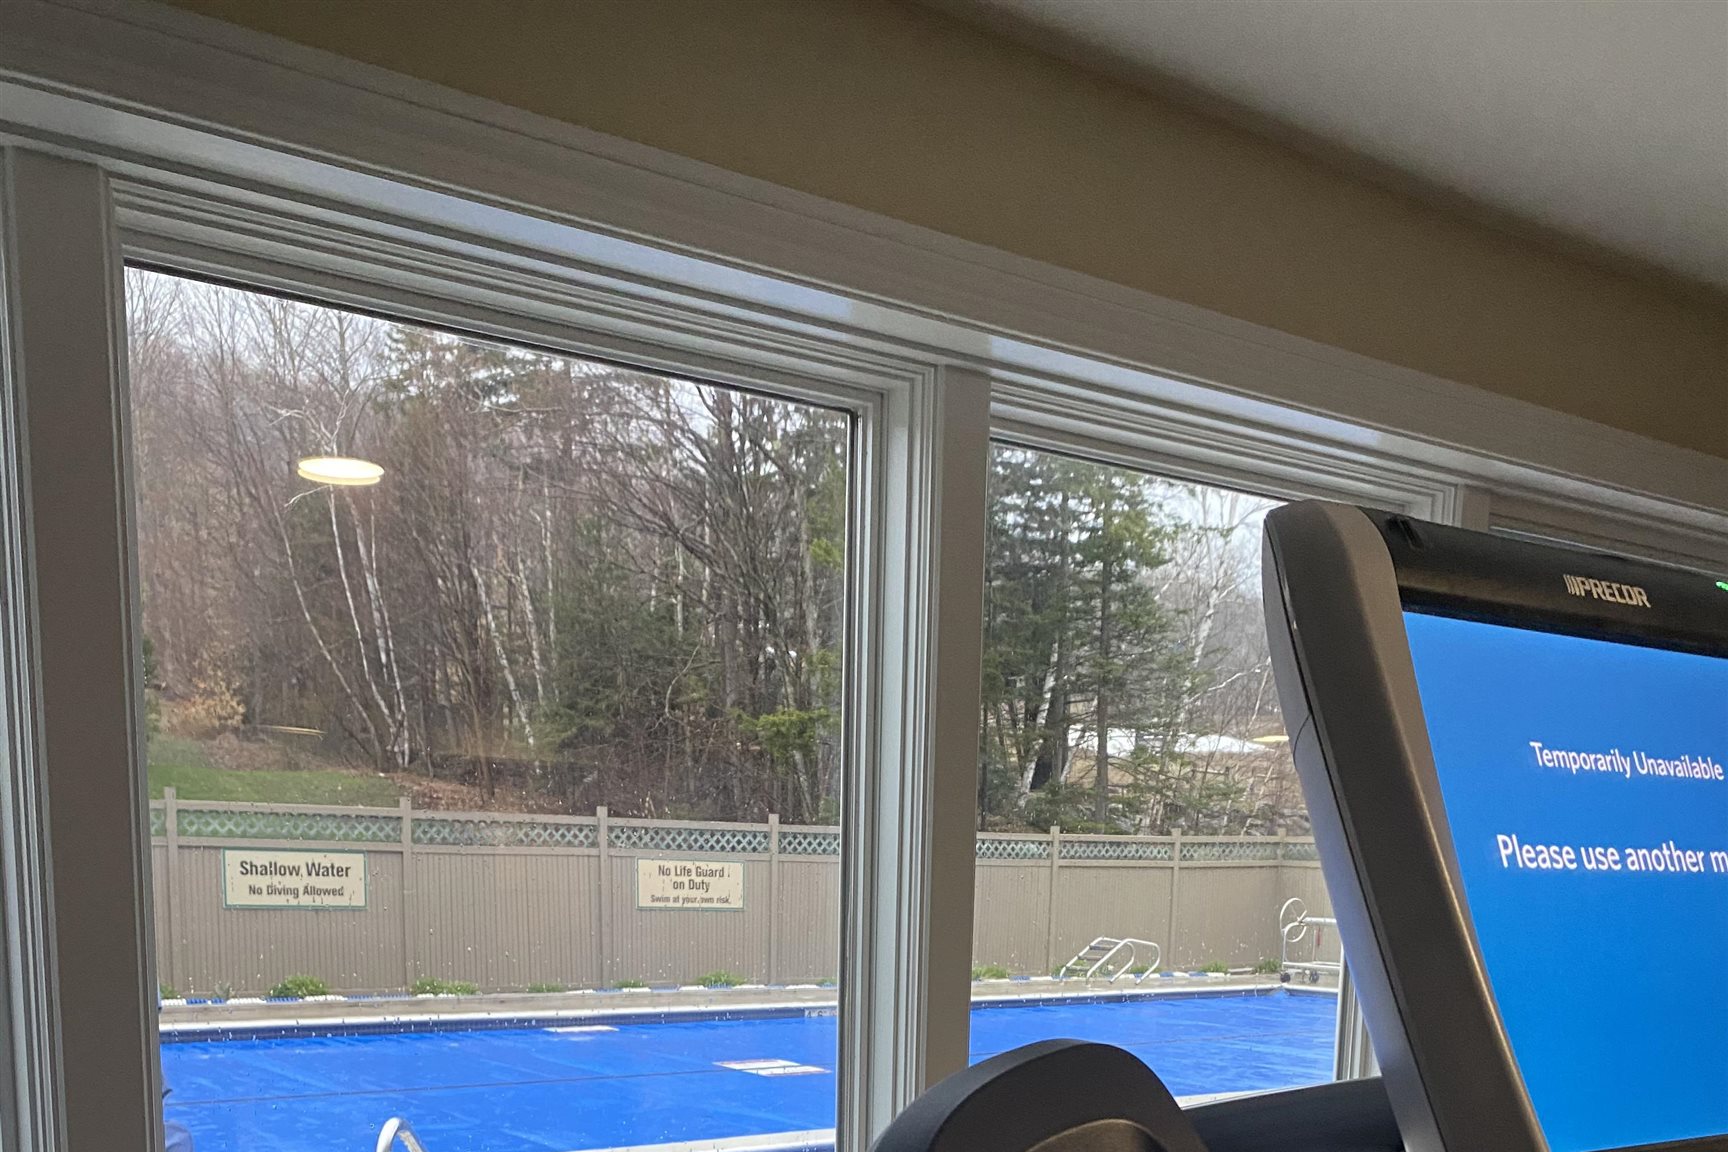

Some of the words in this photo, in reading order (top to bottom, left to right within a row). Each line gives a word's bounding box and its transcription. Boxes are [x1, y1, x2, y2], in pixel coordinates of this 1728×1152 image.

[1574, 574, 1651, 608] PRECOR
[1529, 741, 1631, 779] Temporarily
[1632, 750, 1725, 781] Unavailable
[1496, 833, 1578, 870] Please
[1580, 846, 1622, 871] use
[1625, 840, 1705, 873] another
[239, 860, 301, 876] Shallow
[305, 861, 352, 878] Water
[658, 865, 671, 876] No
[674, 866, 692, 877] Life
[695, 866, 725, 878] Guard
[248, 884, 263, 895] No
[266, 885, 299, 899] Diving
[302, 885, 344, 896] Allowed
[672, 880, 685, 890] on
[688, 879, 711, 893] Duty
[650, 895, 671, 903] Swim
[672, 895, 680, 903] at
[681, 896, 698, 905] your
